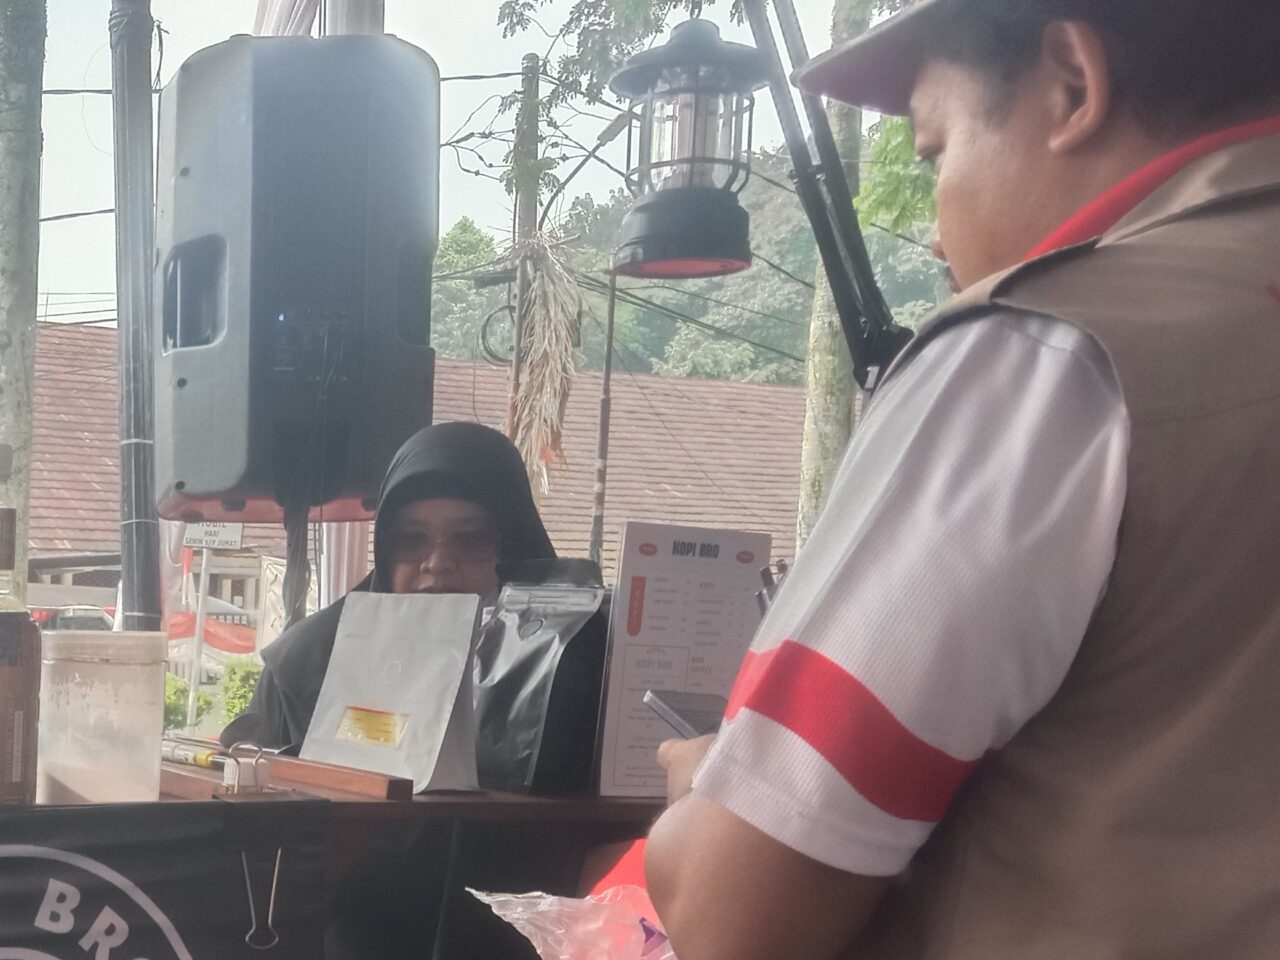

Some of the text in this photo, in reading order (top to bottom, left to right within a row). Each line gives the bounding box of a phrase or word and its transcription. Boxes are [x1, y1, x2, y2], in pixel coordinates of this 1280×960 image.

[185, 537, 203, 545] SENIN
[672, 540, 720, 559] KOPI BRO
